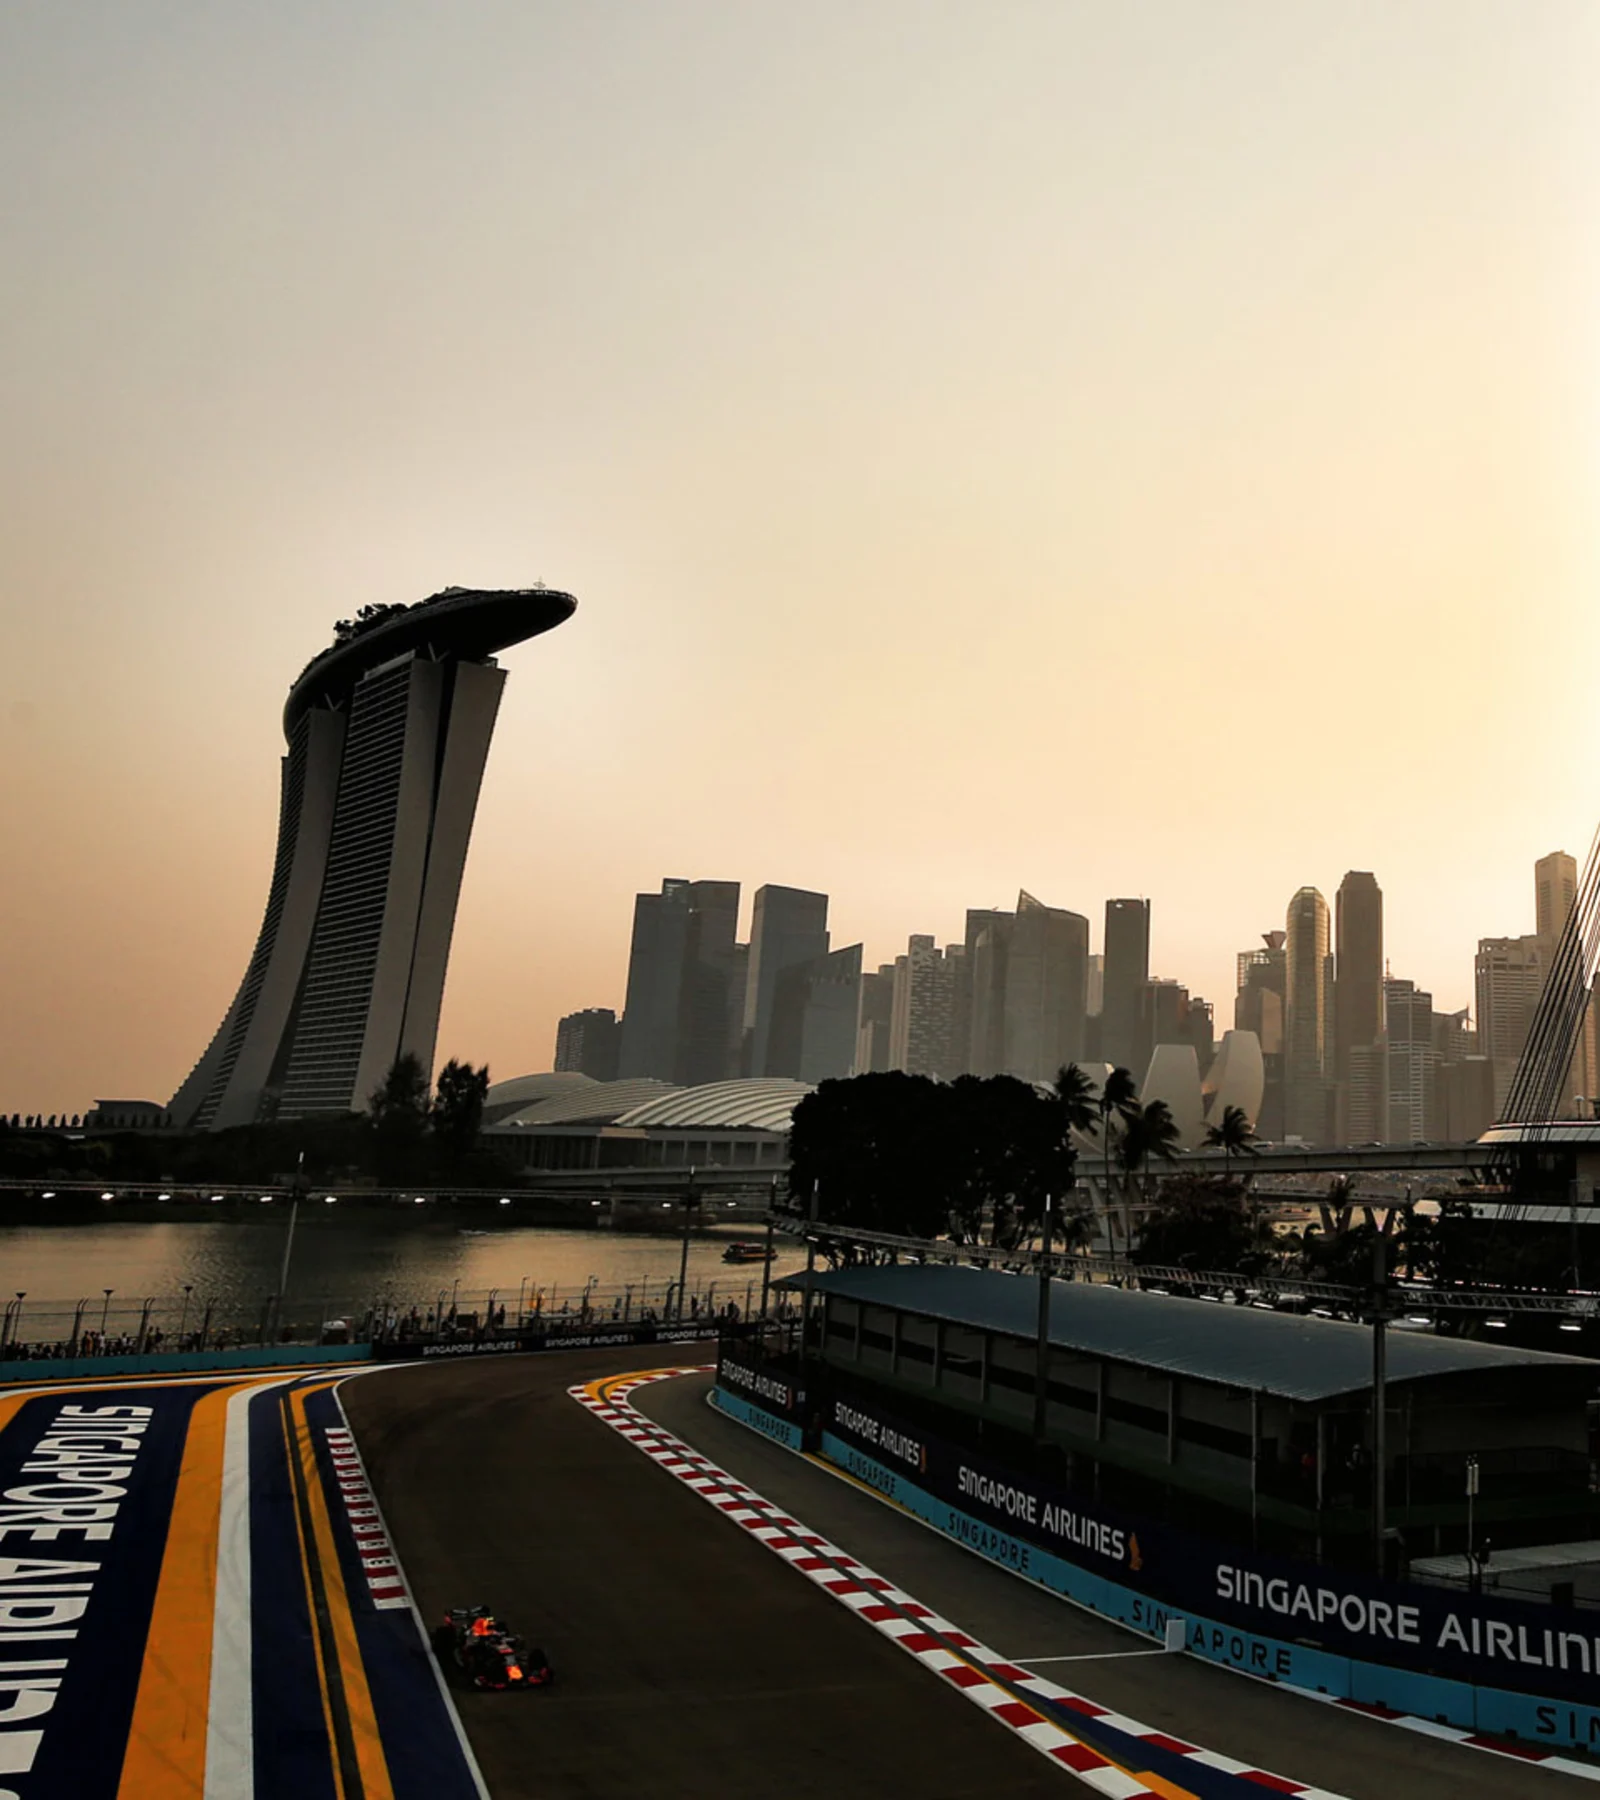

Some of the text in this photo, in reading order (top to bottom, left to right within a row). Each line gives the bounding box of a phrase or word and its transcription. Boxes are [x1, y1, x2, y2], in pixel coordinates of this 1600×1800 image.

[422, 1340, 516, 1356] SINGAPORE AIRLINES
[545, 1333, 629, 1348] SINGAPORE AIRLINES
[721, 1358, 788, 1406] SINGAPORE AIRLINES
[836, 1401, 920, 1467] SINGAPORE AIRLINES
[948, 1512, 1030, 1570] SINGAPORE
[957, 1465, 1126, 1562] SINGAPORE AIRLINES
[1215, 1563, 1421, 1645] SINGAPORE
[1132, 1599, 1291, 1675] SINAPORE
